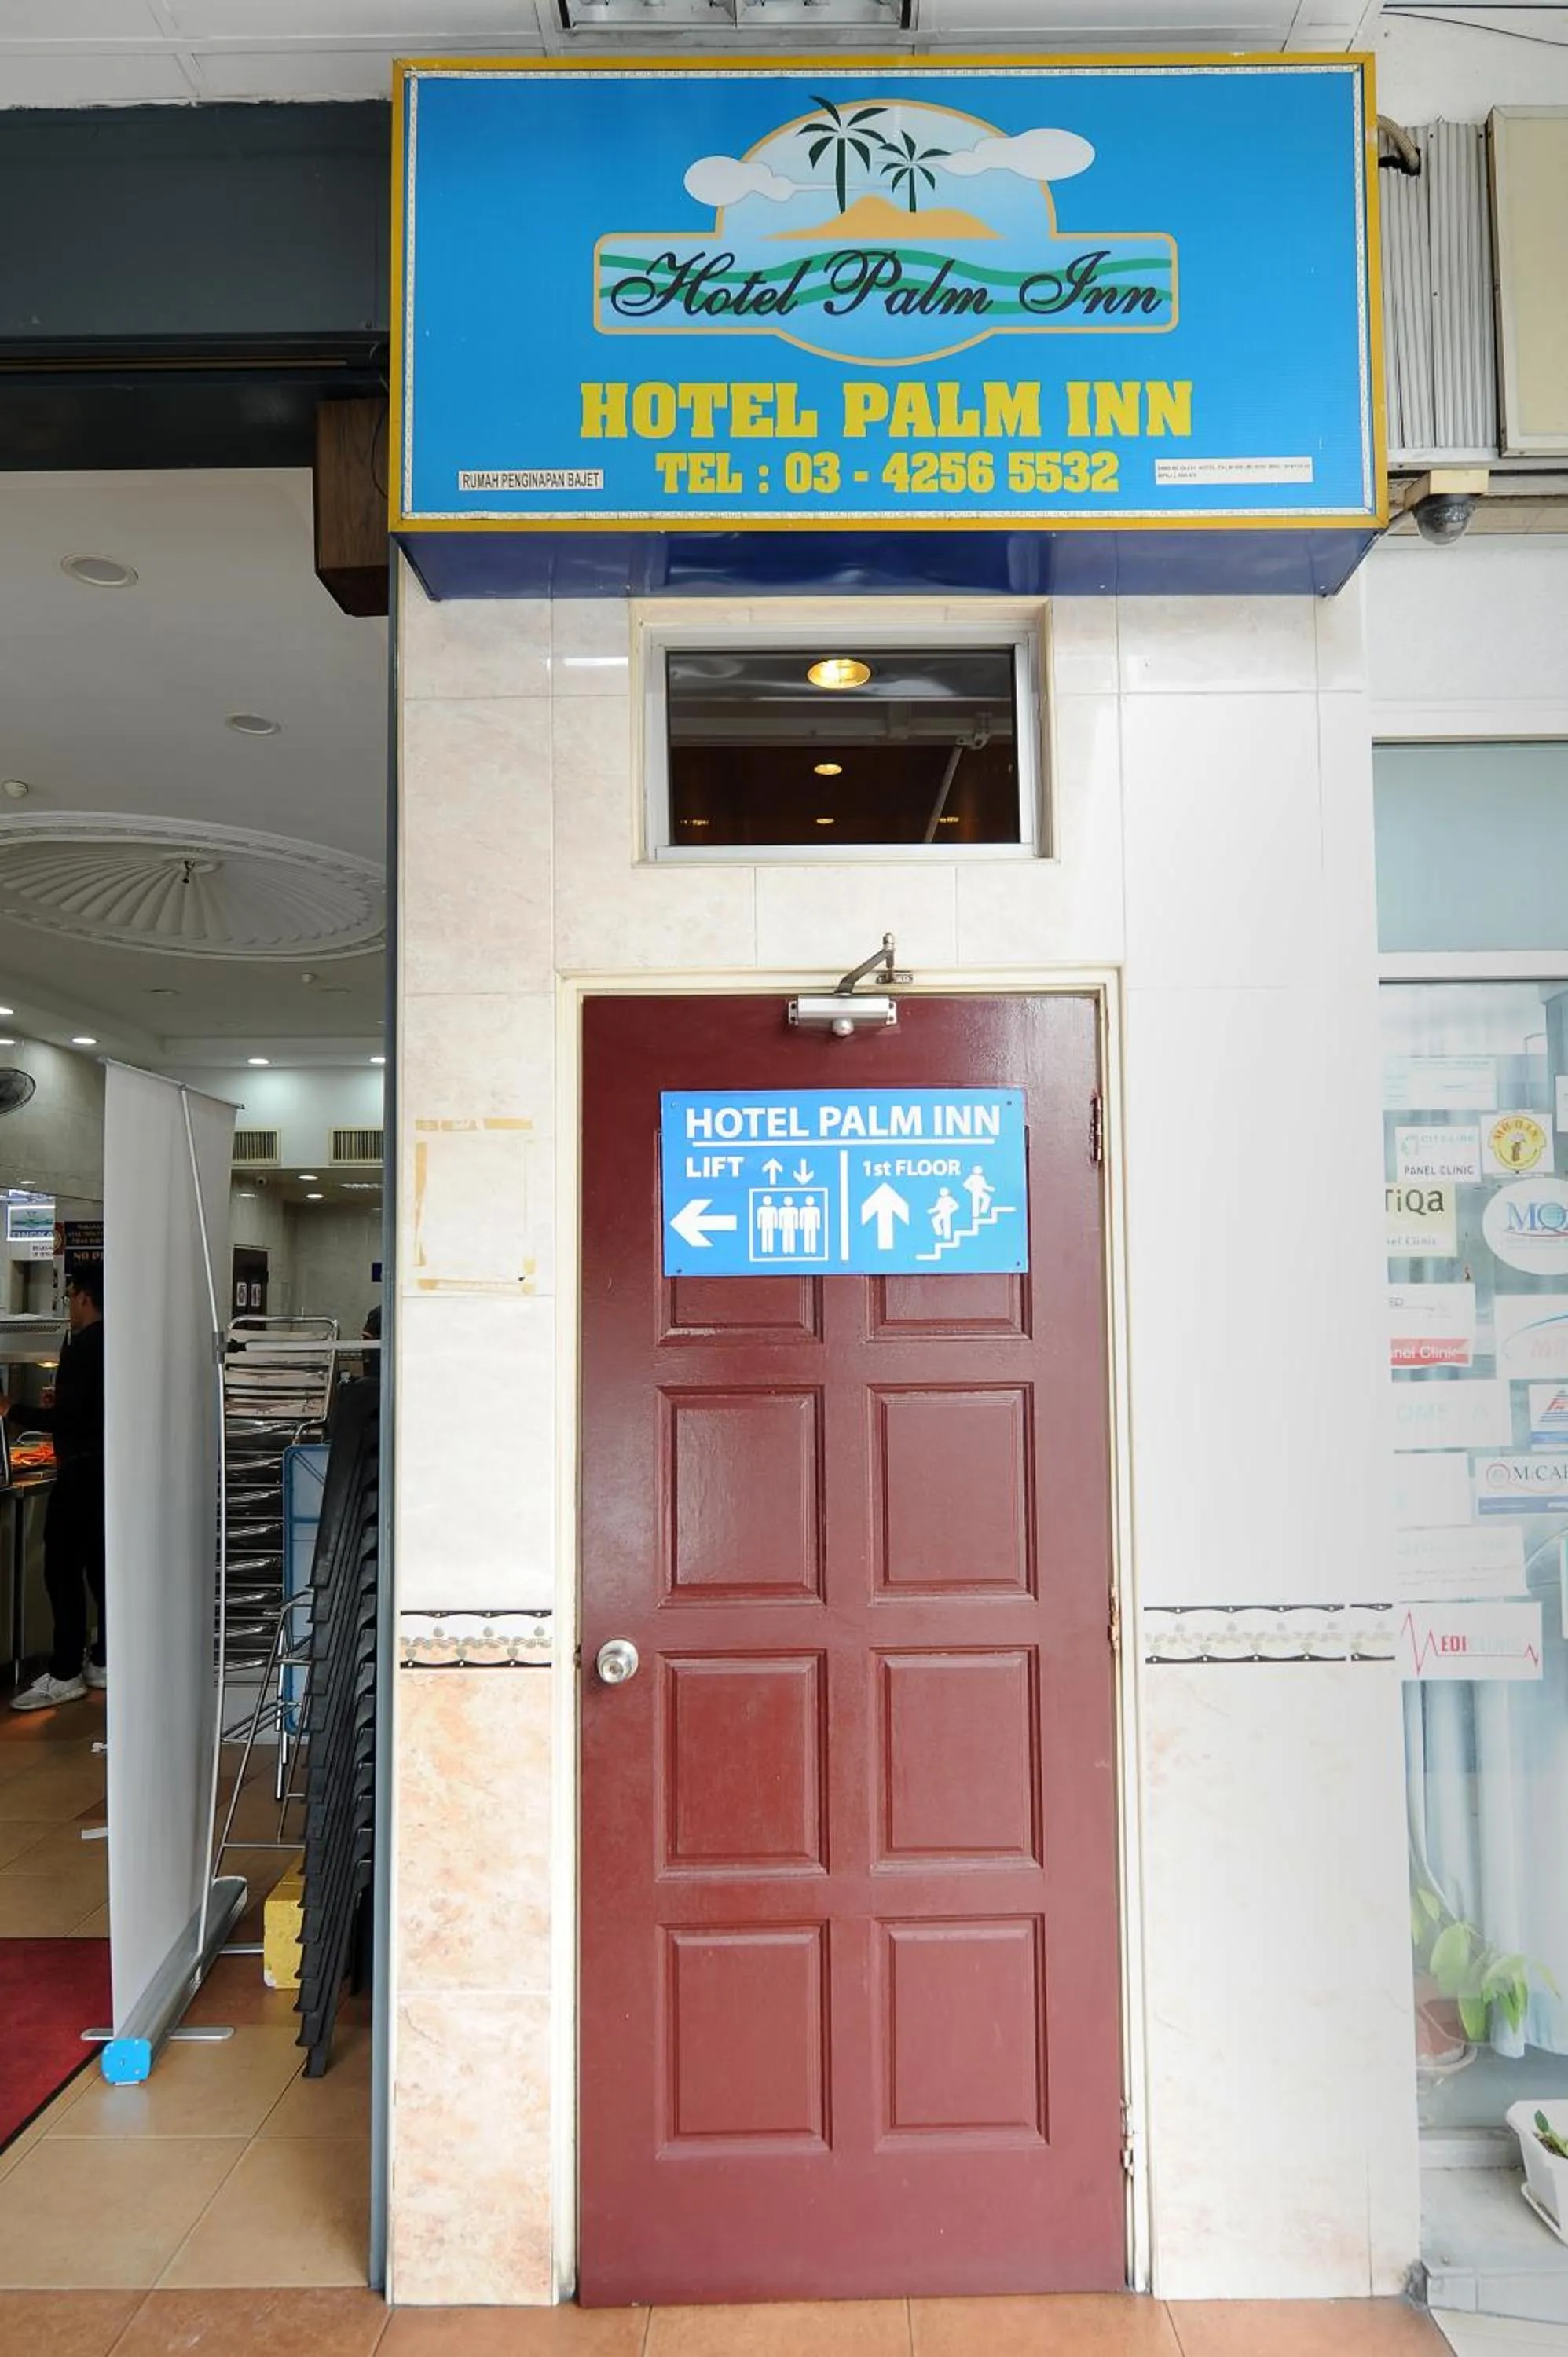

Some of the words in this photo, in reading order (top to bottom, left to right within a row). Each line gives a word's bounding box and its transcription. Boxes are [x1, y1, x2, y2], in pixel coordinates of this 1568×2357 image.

[611, 251, 815, 317] Hotel
[823, 249, 995, 317] Palm
[1019, 251, 1163, 315] Inn
[581, 383, 818, 438] HOTEL
[843, 382, 1042, 438] PALM
[1067, 381, 1192, 437] INN
[463, 474, 499, 489] RUMAH
[501, 473, 565, 488] PENGINAPAN
[568, 472, 599, 487] BAJET
[656, 453, 743, 493] TEL
[786, 452, 841, 493] 03
[883, 452, 995, 493] 4256
[1009, 451, 1119, 493] 5532
[687, 1107, 810, 1139] HOTEL
[819, 1105, 923, 1137] PALM
[934, 1105, 1001, 1136] INN
[686, 1157, 745, 1178] LIFT
[863, 1160, 892, 1177] 1st
[895, 1159, 962, 1177] FLOOR
[1403, 1164, 1437, 1176] PANEL
[1439, 1164, 1475, 1176] CLINIC
